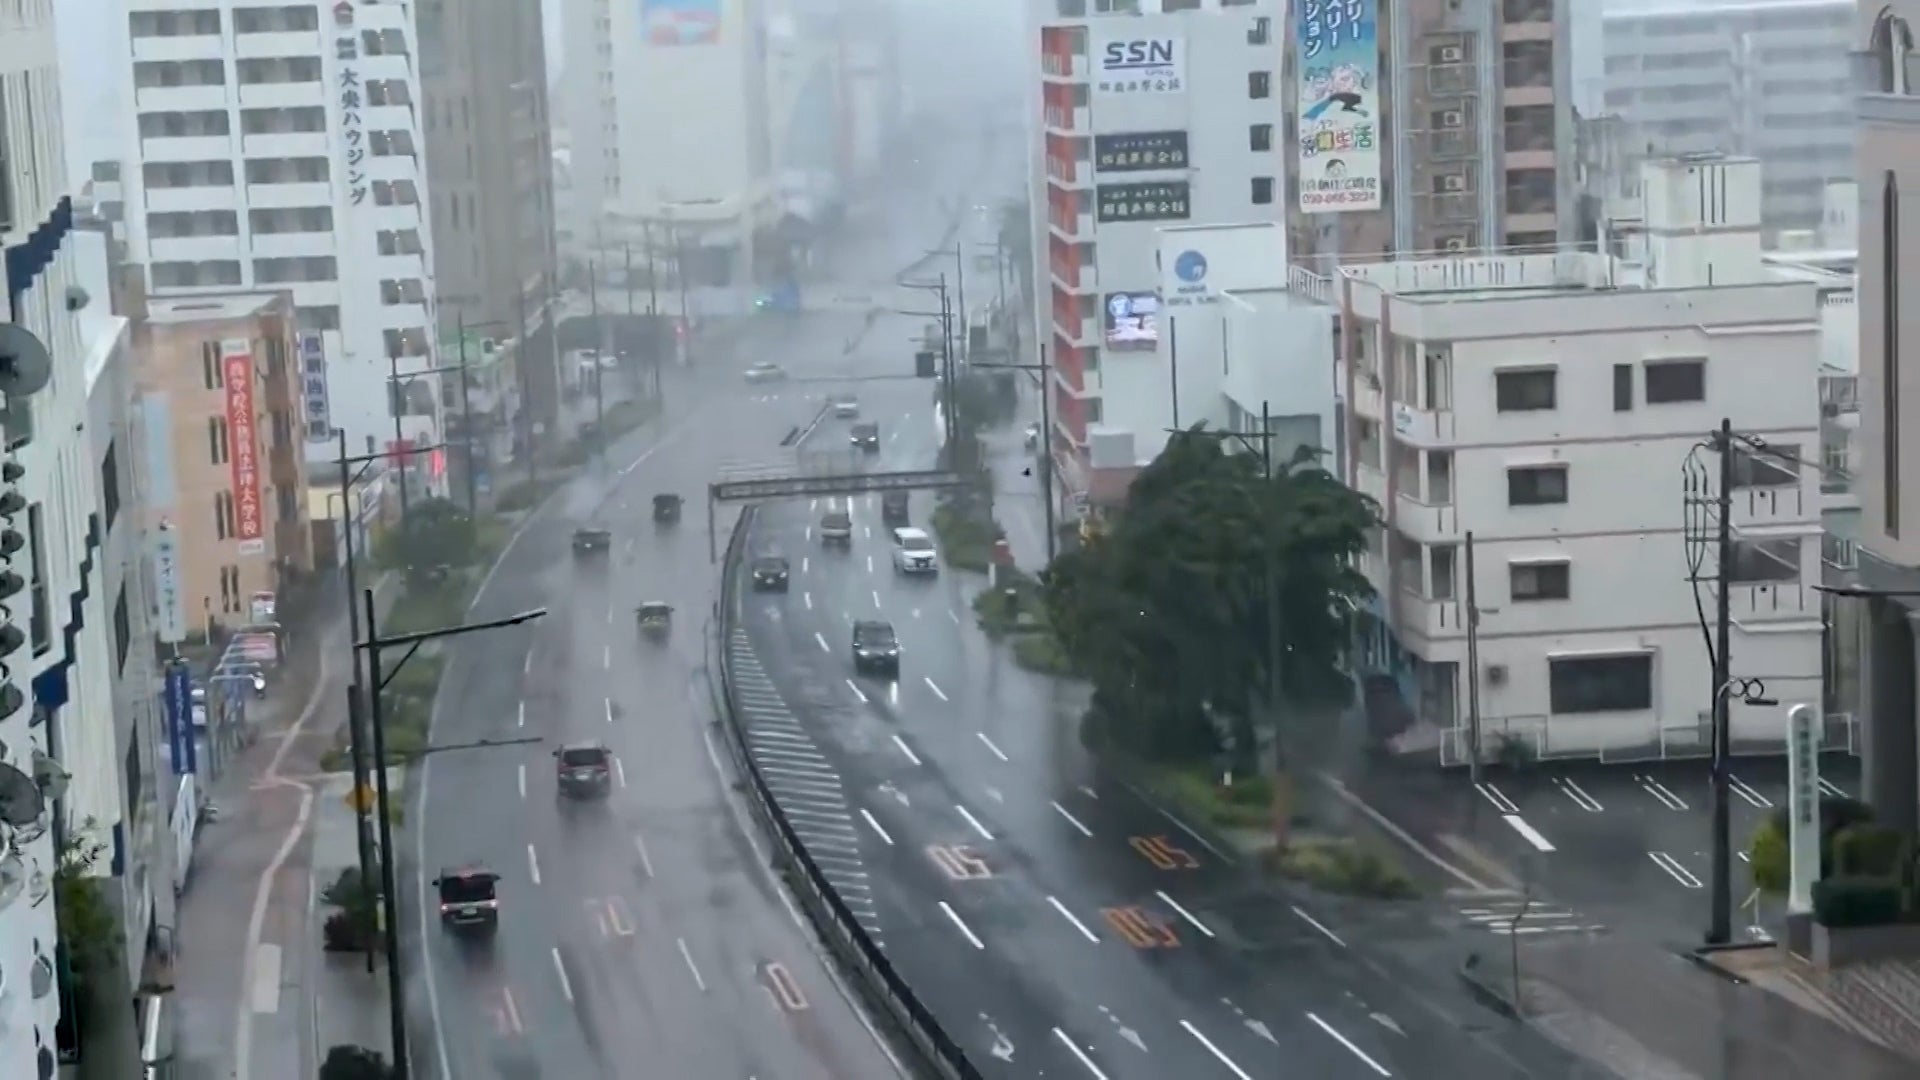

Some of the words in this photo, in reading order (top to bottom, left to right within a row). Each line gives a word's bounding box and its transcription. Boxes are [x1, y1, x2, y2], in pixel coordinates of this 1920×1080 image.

[1305, 0, 1322, 58] ション
[1346, 0, 1362, 38] リー
[1103, 39, 1173, 64] SSN
